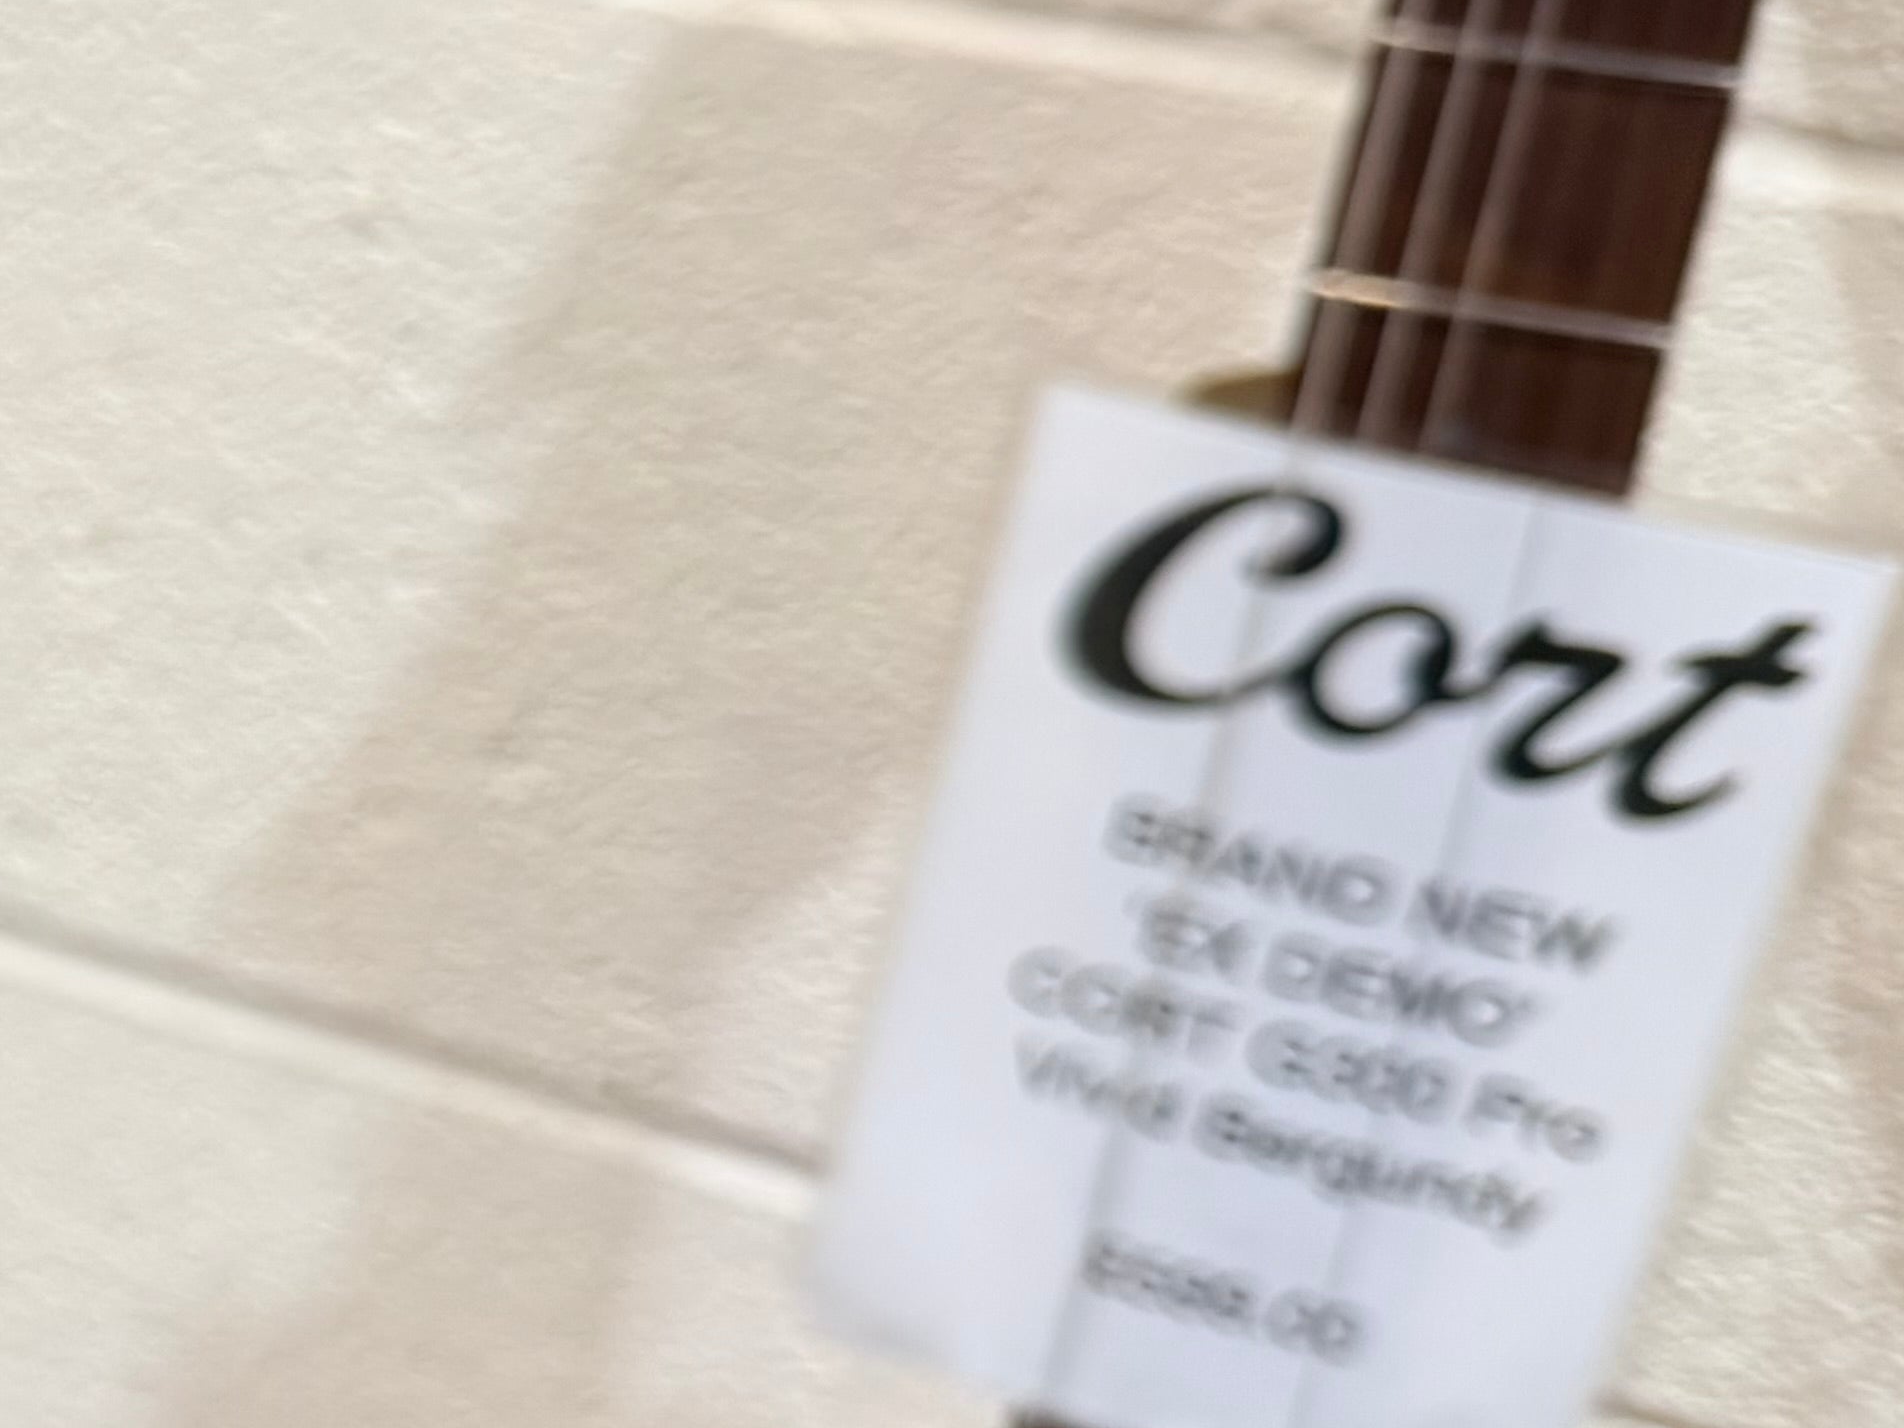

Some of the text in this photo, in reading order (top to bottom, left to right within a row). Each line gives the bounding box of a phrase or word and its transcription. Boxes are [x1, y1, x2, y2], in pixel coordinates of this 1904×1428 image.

[1060, 484, 1818, 824] Cort
[1106, 796, 1614, 970] BRAND NEW
[1010, 948, 1238, 1054] CORT
[1468, 1076, 1602, 1162] Pro
[1017, 1036, 1548, 1244] Vivid Burgundy
